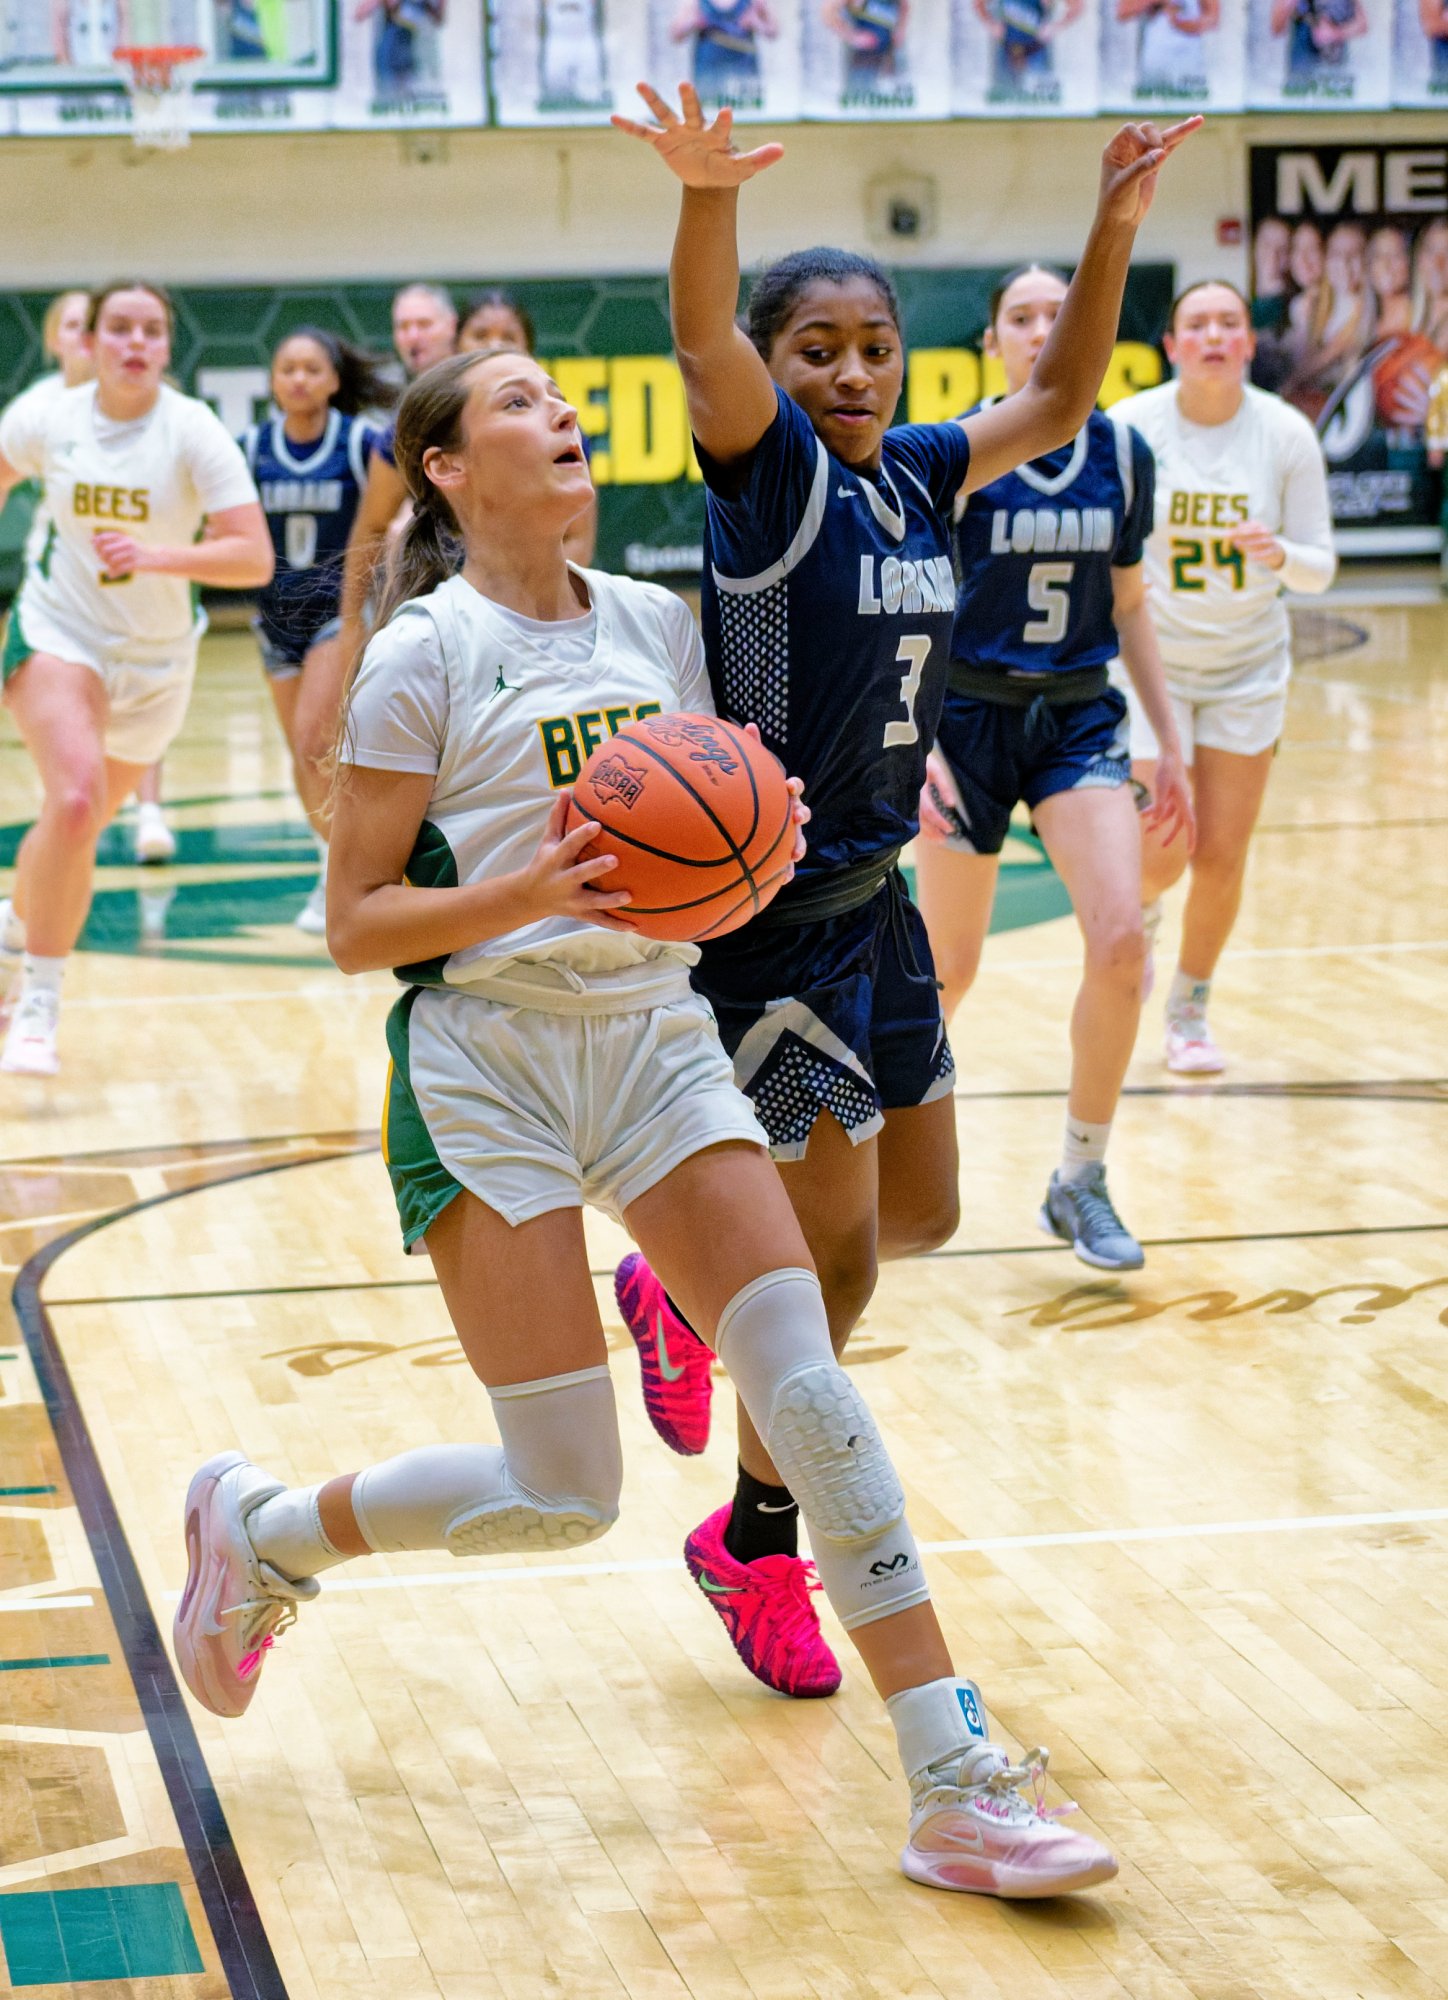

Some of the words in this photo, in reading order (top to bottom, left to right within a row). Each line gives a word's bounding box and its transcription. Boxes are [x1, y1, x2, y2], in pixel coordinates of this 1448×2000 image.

[1276, 152, 1448, 214] ME
[73, 482, 149, 522] BEES
[1168, 491, 1249, 527] BEES
[285, 514, 318, 570] 0
[989, 507, 1114, 554] LORAIN
[1168, 536, 1246, 592] 24
[1023, 561, 1075, 643] 5
[883, 634, 932, 748] 3
